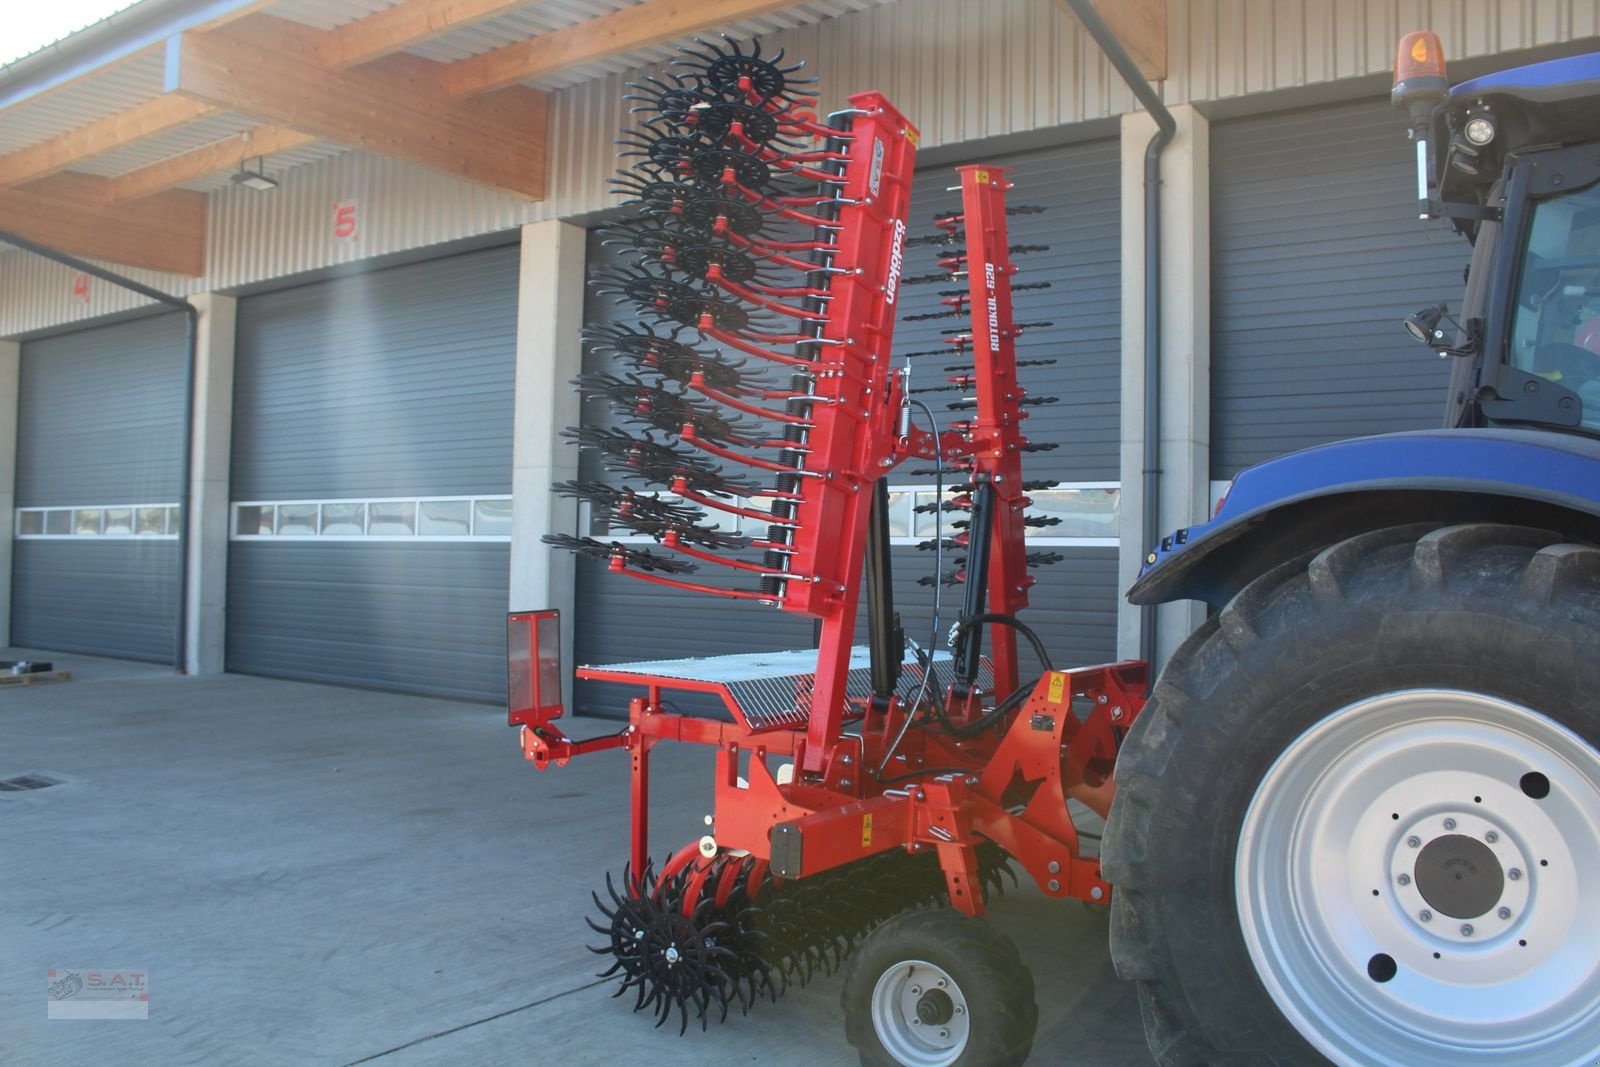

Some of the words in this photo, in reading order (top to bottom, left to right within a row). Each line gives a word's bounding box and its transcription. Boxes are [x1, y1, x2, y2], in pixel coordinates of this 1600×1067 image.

[335, 206, 356, 237] 5
[886, 219, 906, 304] özdöken
[73, 271, 90, 299] 4
